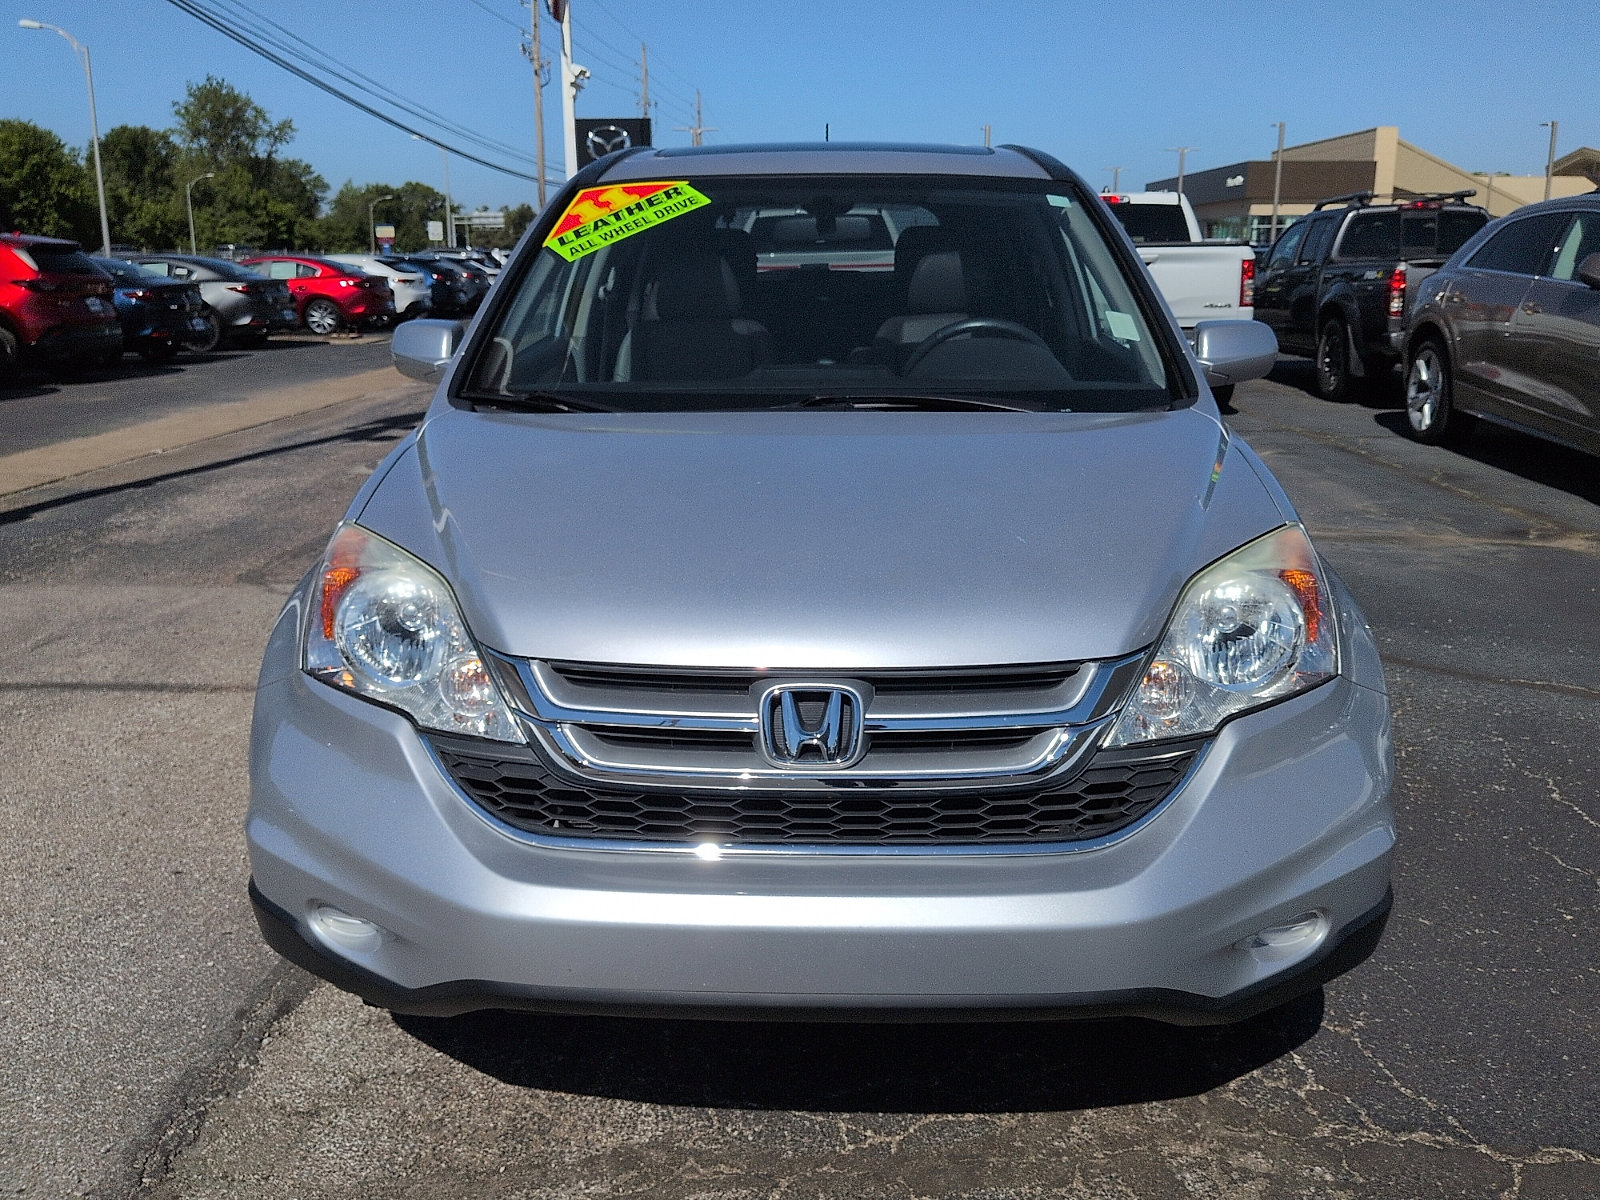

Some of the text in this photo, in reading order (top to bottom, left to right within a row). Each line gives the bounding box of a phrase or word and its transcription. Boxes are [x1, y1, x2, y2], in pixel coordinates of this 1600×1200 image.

[557, 187, 683, 246] LEATHER
[569, 197, 698, 256] ALL WHEEL DRIVE
